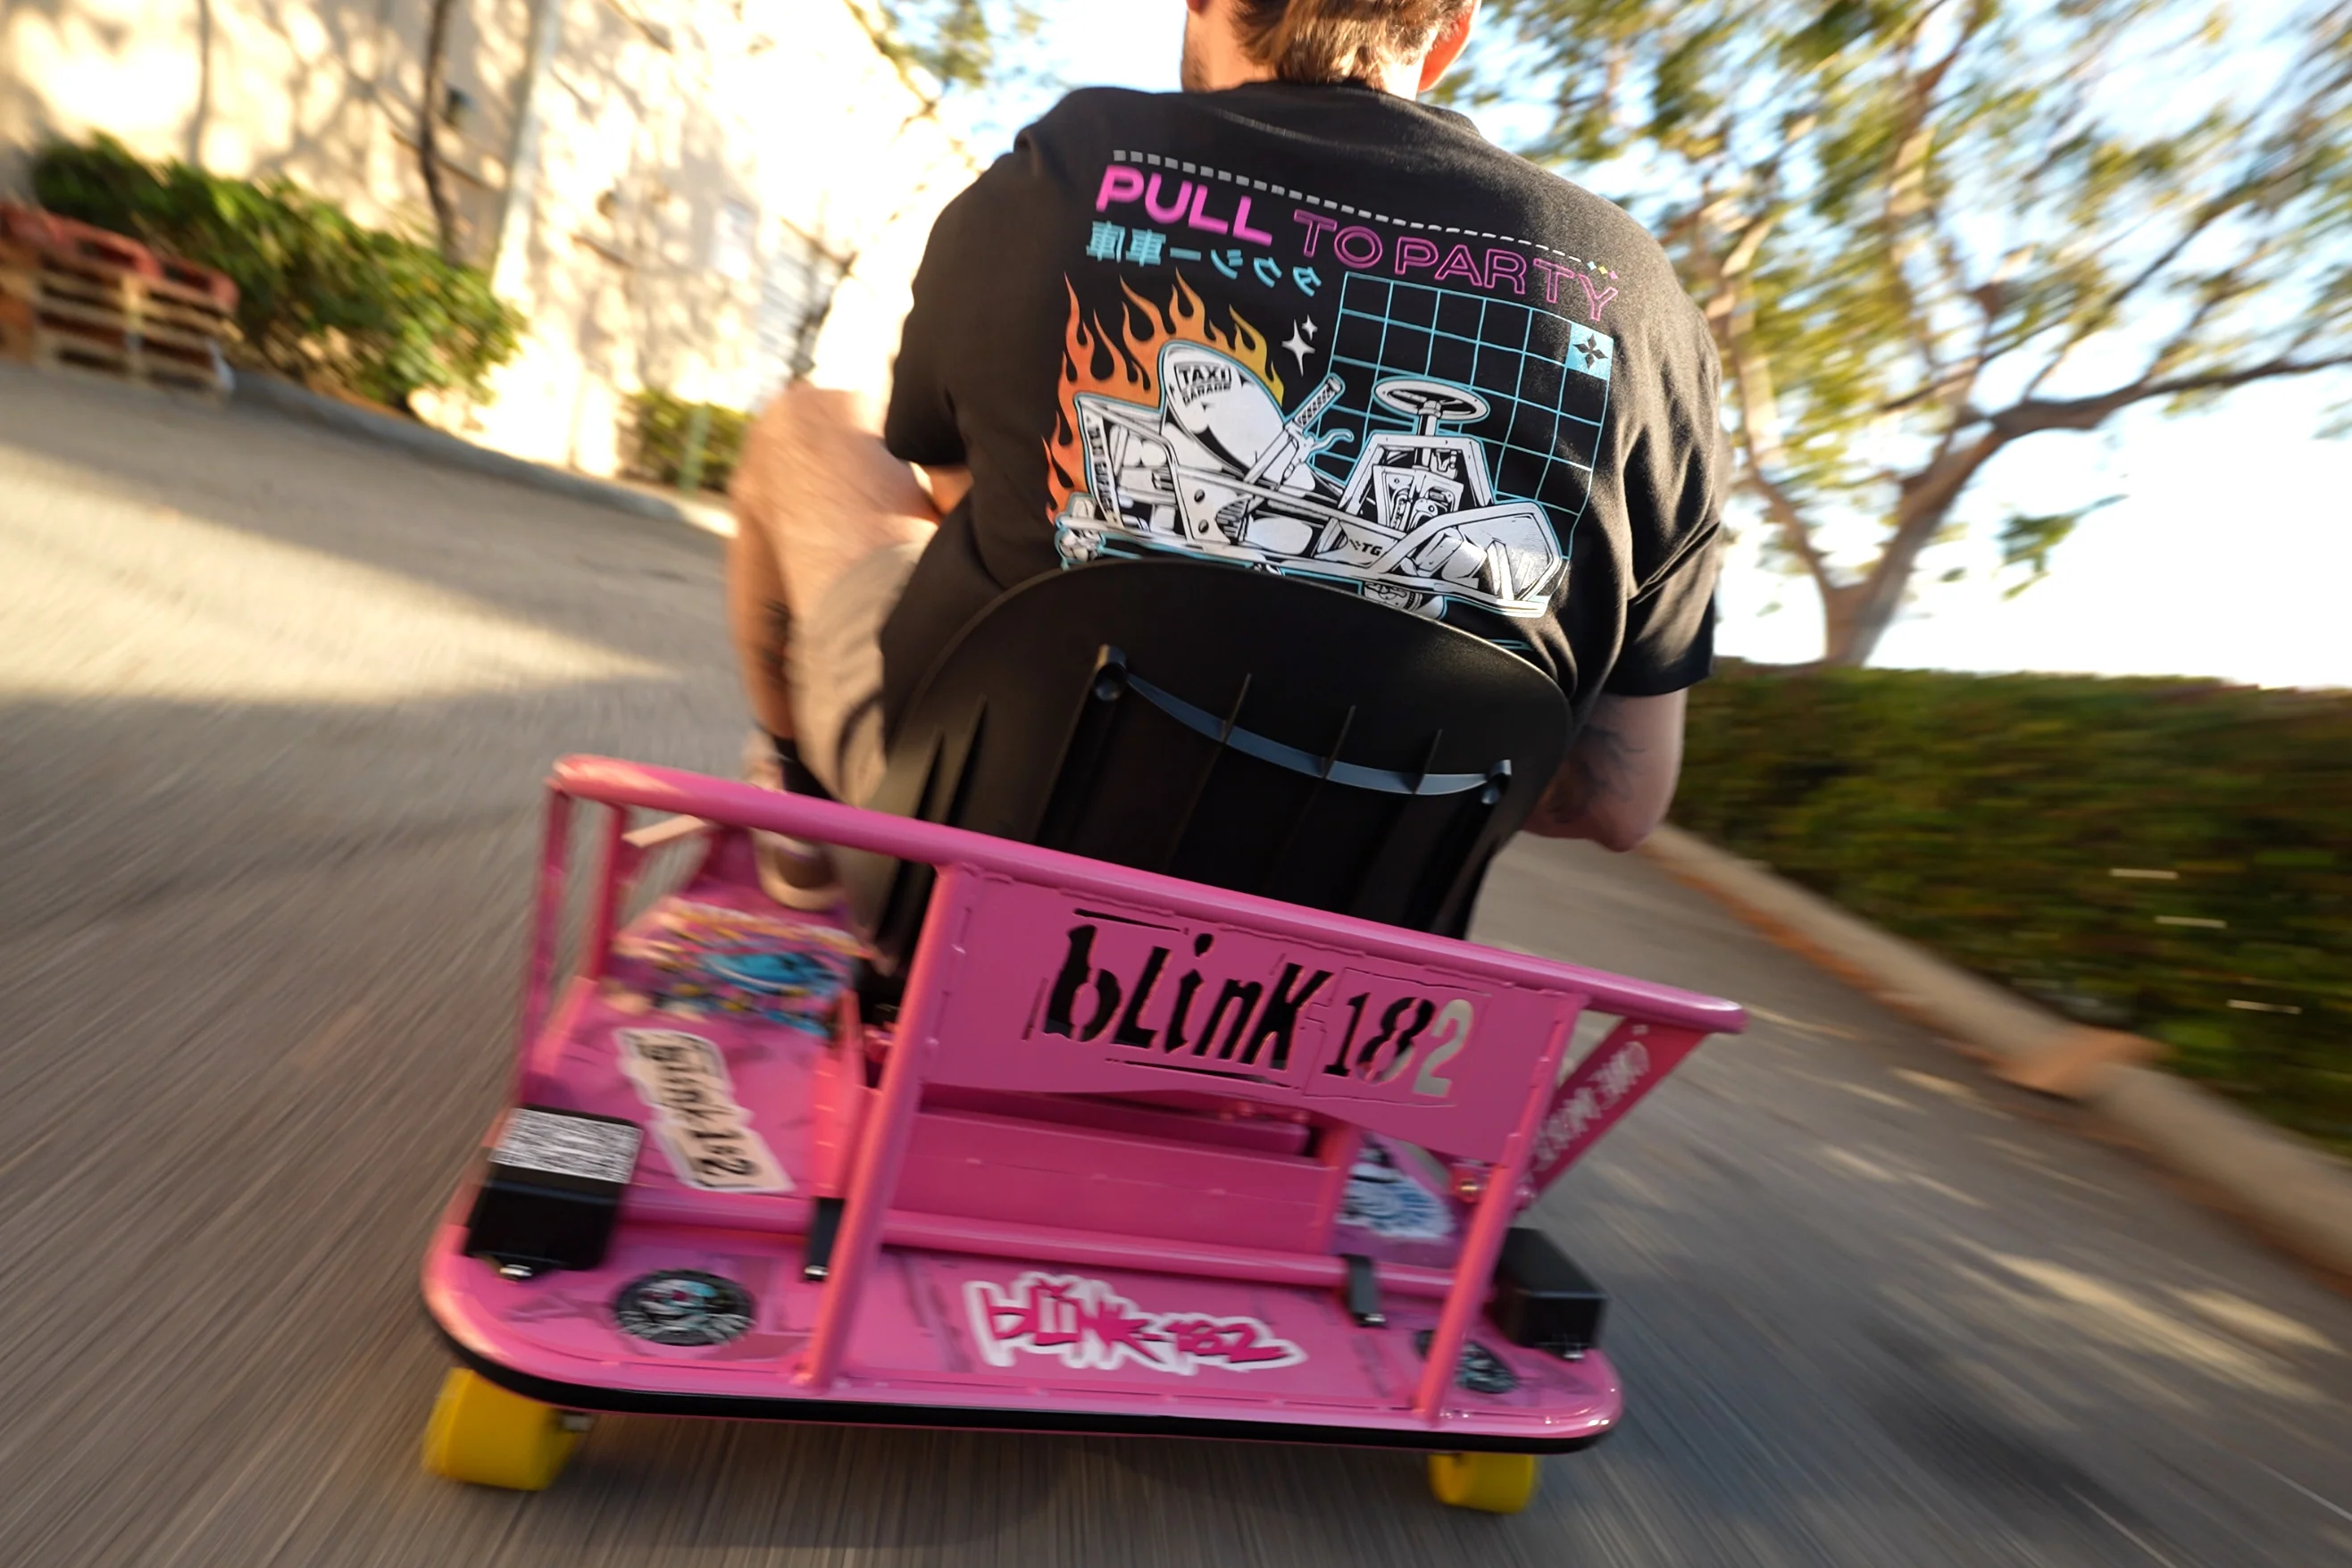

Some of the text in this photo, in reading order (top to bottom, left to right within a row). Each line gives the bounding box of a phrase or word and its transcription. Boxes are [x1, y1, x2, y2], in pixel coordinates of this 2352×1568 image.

[1096, 164, 1618, 321] PULL TO PARTY
[1178, 363, 1227, 385] TAXI
[1322, 991, 1473, 1097] 182
